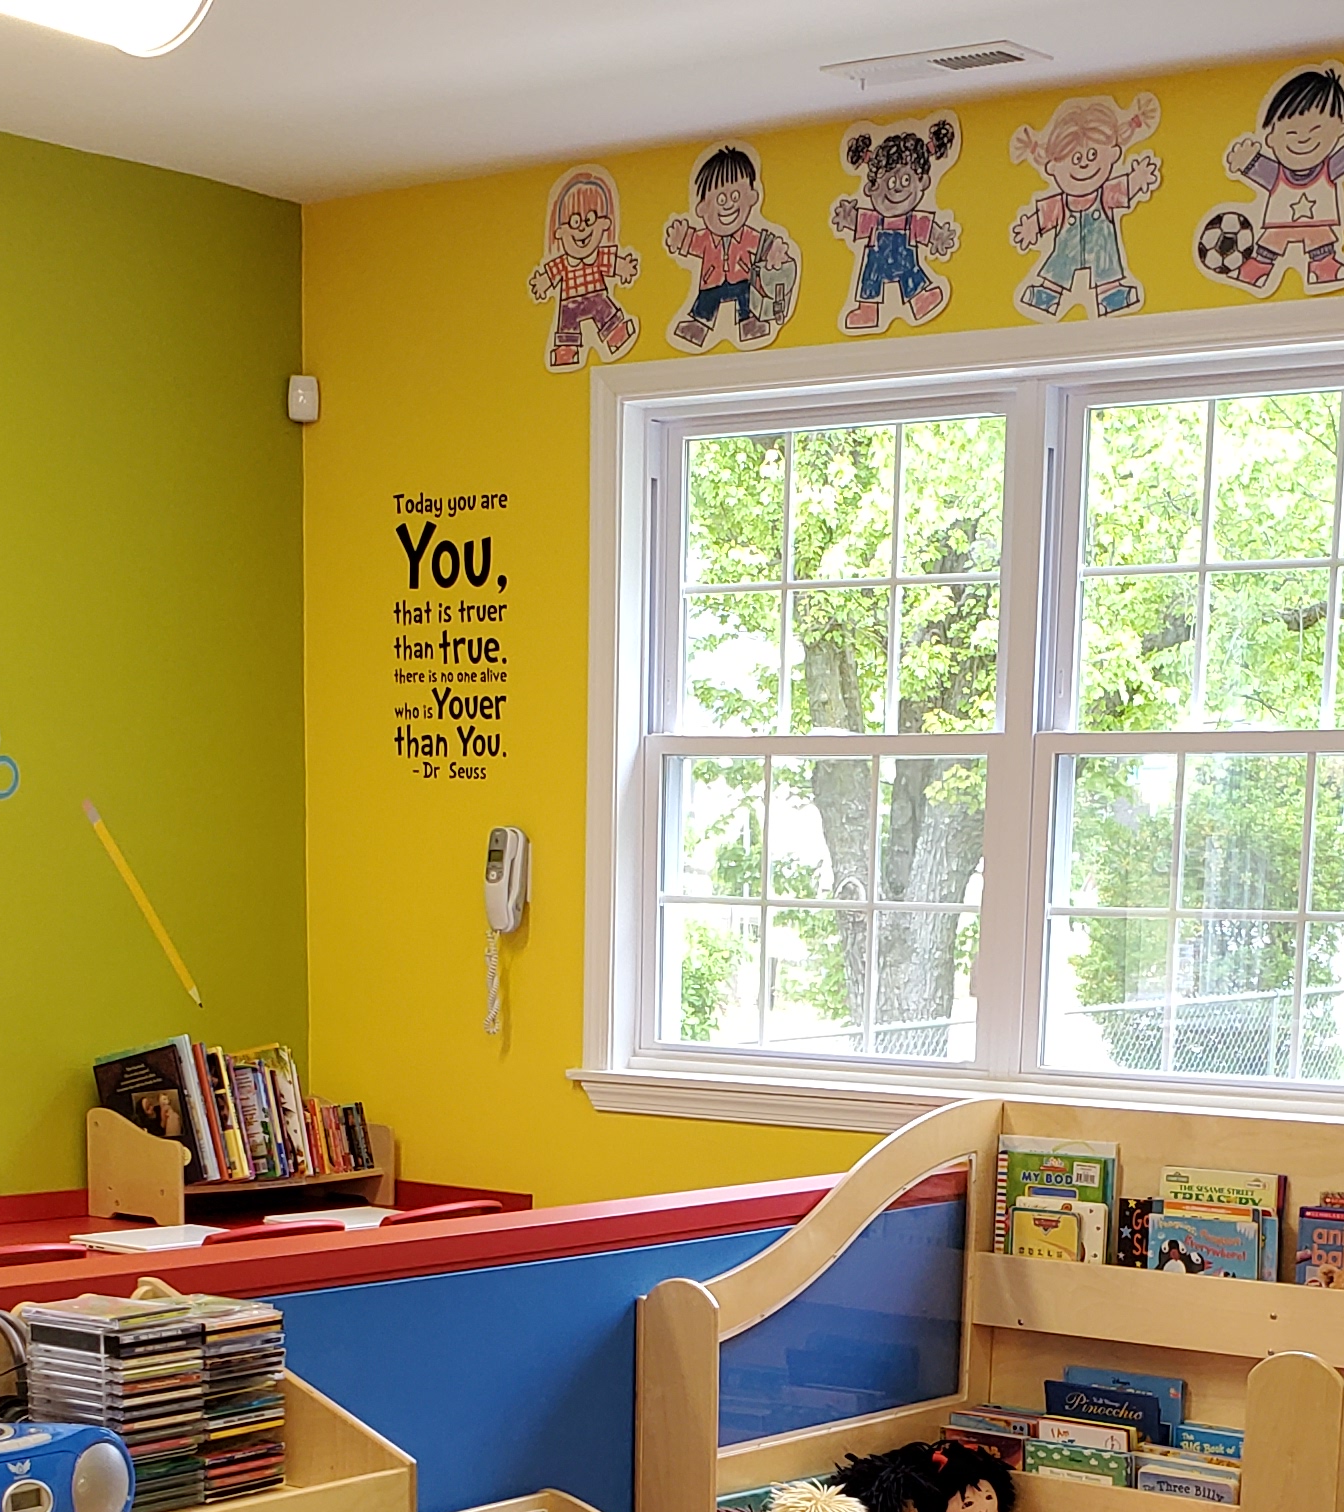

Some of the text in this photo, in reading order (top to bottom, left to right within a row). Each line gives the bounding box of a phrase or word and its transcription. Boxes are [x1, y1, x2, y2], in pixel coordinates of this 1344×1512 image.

[393, 492, 508, 517] Today you are
[395, 521, 508, 593] You,
[393, 600, 508, 626] that is truer
[393, 629, 508, 665] than true.
[394, 667, 508, 684] there is no one alive
[395, 686, 507, 720] who is Youer
[394, 724, 508, 758] than You.
[449, 761, 487, 780] Seuss
[1021, 1171, 1073, 1185] MY BOD
[1064, 1391, 1144, 1421] Pinocchio
[1181, 1441, 1224, 1454] BIG Book
[1157, 1481, 1224, 1503] Three Billy
